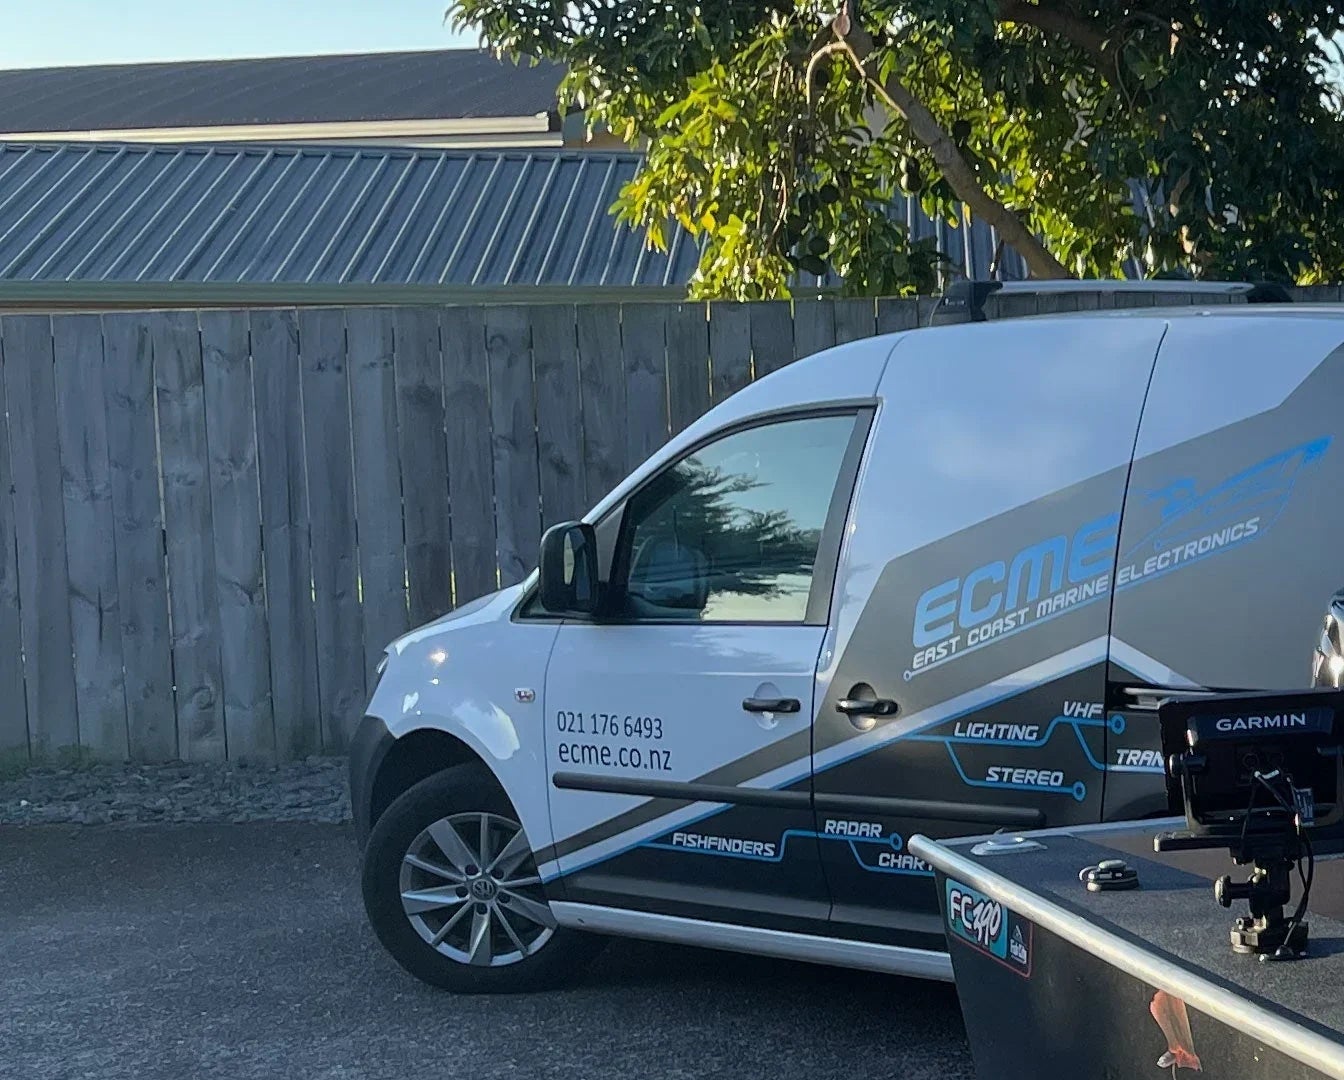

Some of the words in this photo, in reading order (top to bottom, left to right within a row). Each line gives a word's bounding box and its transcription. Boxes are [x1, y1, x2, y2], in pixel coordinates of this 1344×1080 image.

[912, 511, 1121, 648] ECME
[912, 636, 961, 670] EAST
[967, 607, 1030, 647] COAST
[1036, 574, 1109, 618] MARINE
[1116, 517, 1261, 586] ELECTRONICS
[1063, 701, 1104, 718] VHF
[557, 711, 585, 733] 021
[591, 713, 619, 736] 176
[624, 716, 663, 739] 6493
[954, 722, 1039, 741] LIGHTING
[1216, 713, 1306, 731] GARMIN
[559, 743, 672, 770] ecme.co.nz
[986, 767, 1064, 786] STEREO
[824, 819, 882, 838] RADAR
[672, 832, 776, 857] FISHFINDERS
[878, 852, 933, 871] CHAR
